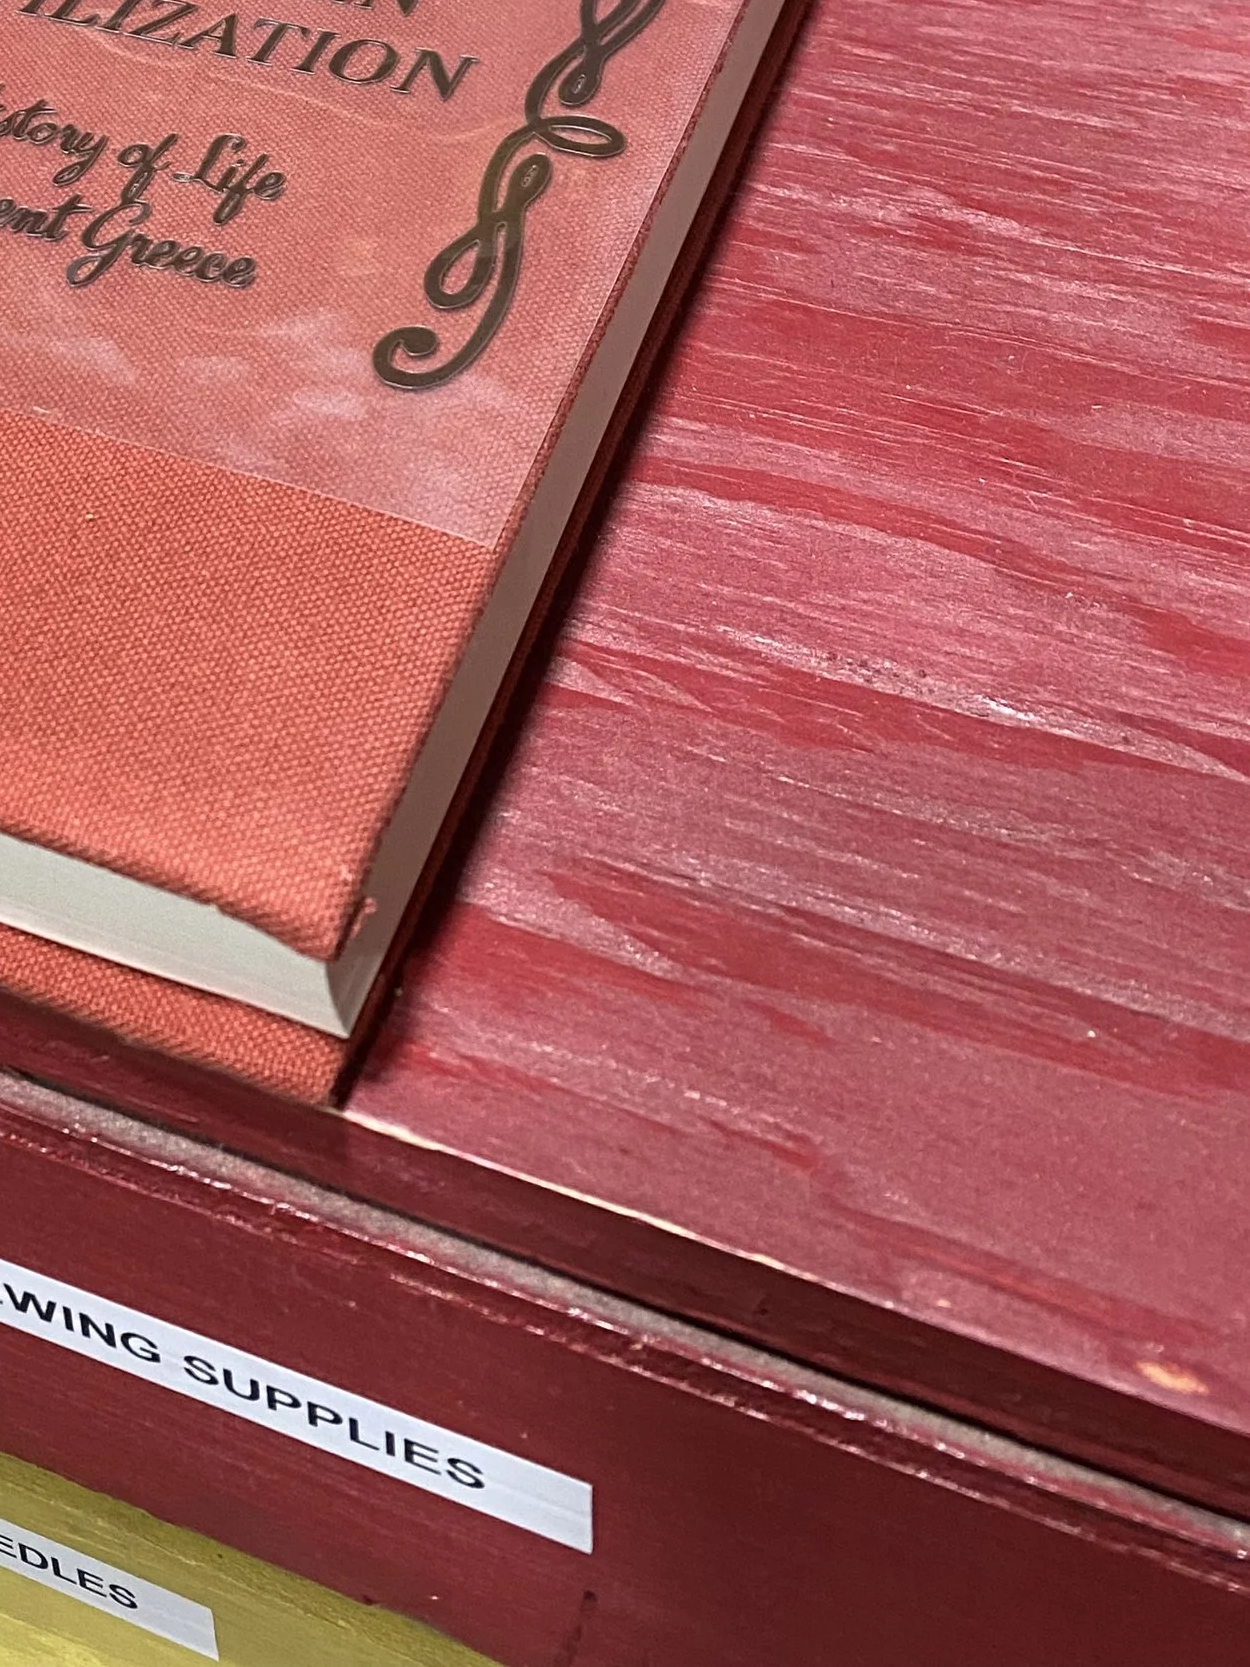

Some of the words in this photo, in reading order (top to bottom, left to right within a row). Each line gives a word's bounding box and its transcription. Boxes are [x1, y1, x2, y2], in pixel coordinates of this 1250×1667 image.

[117, 133, 178, 205] of
[173, 133, 286, 226] Life
[65, 198, 256, 288] Greece
[182, 1355, 487, 1490] SUPPLIES
